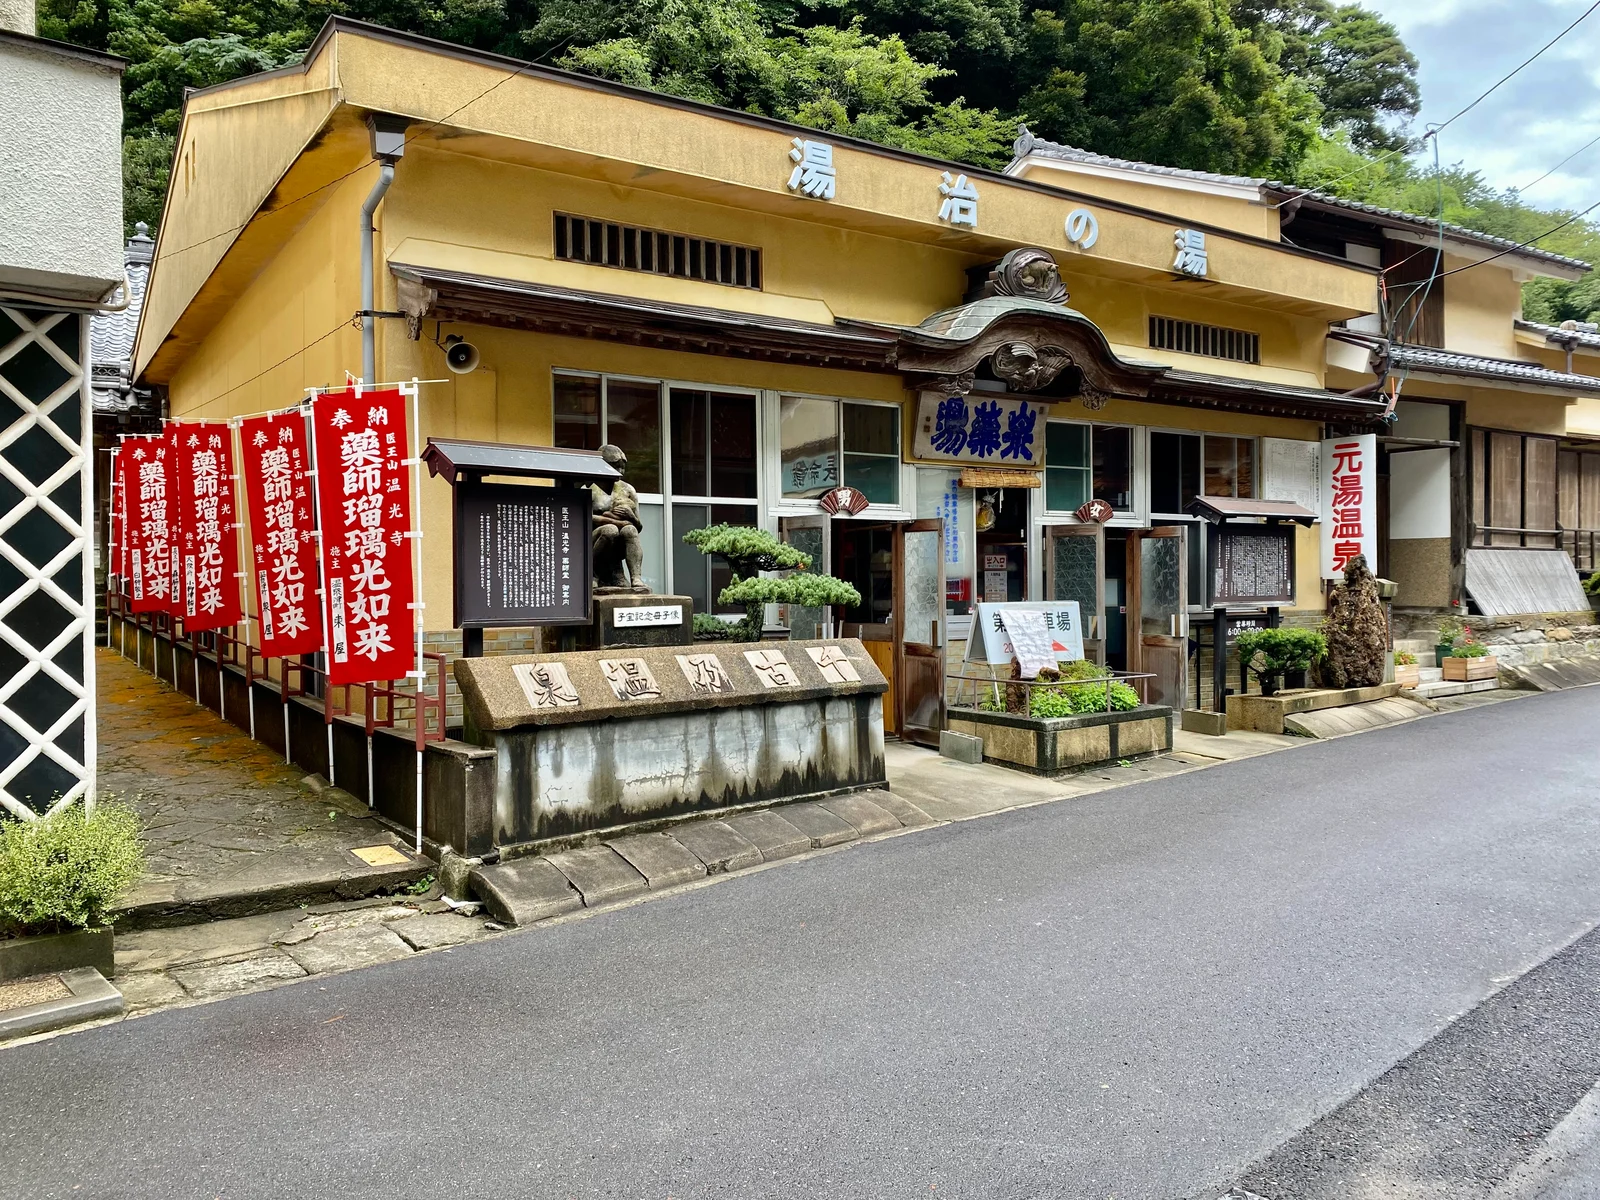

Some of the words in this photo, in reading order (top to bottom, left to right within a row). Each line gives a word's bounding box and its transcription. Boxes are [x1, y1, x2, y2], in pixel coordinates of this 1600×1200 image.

[787, 136, 1208, 277] 湯治の湯
[330, 406, 389, 430] 奉納
[186, 432, 222, 449] 奉納
[252, 426, 294, 448] 奉納
[837, 489, 852, 507] 男
[1331, 442, 1364, 572] 元湯温泉
[1090, 503, 1104, 517] 女
[330, 546, 341, 570] 施主
